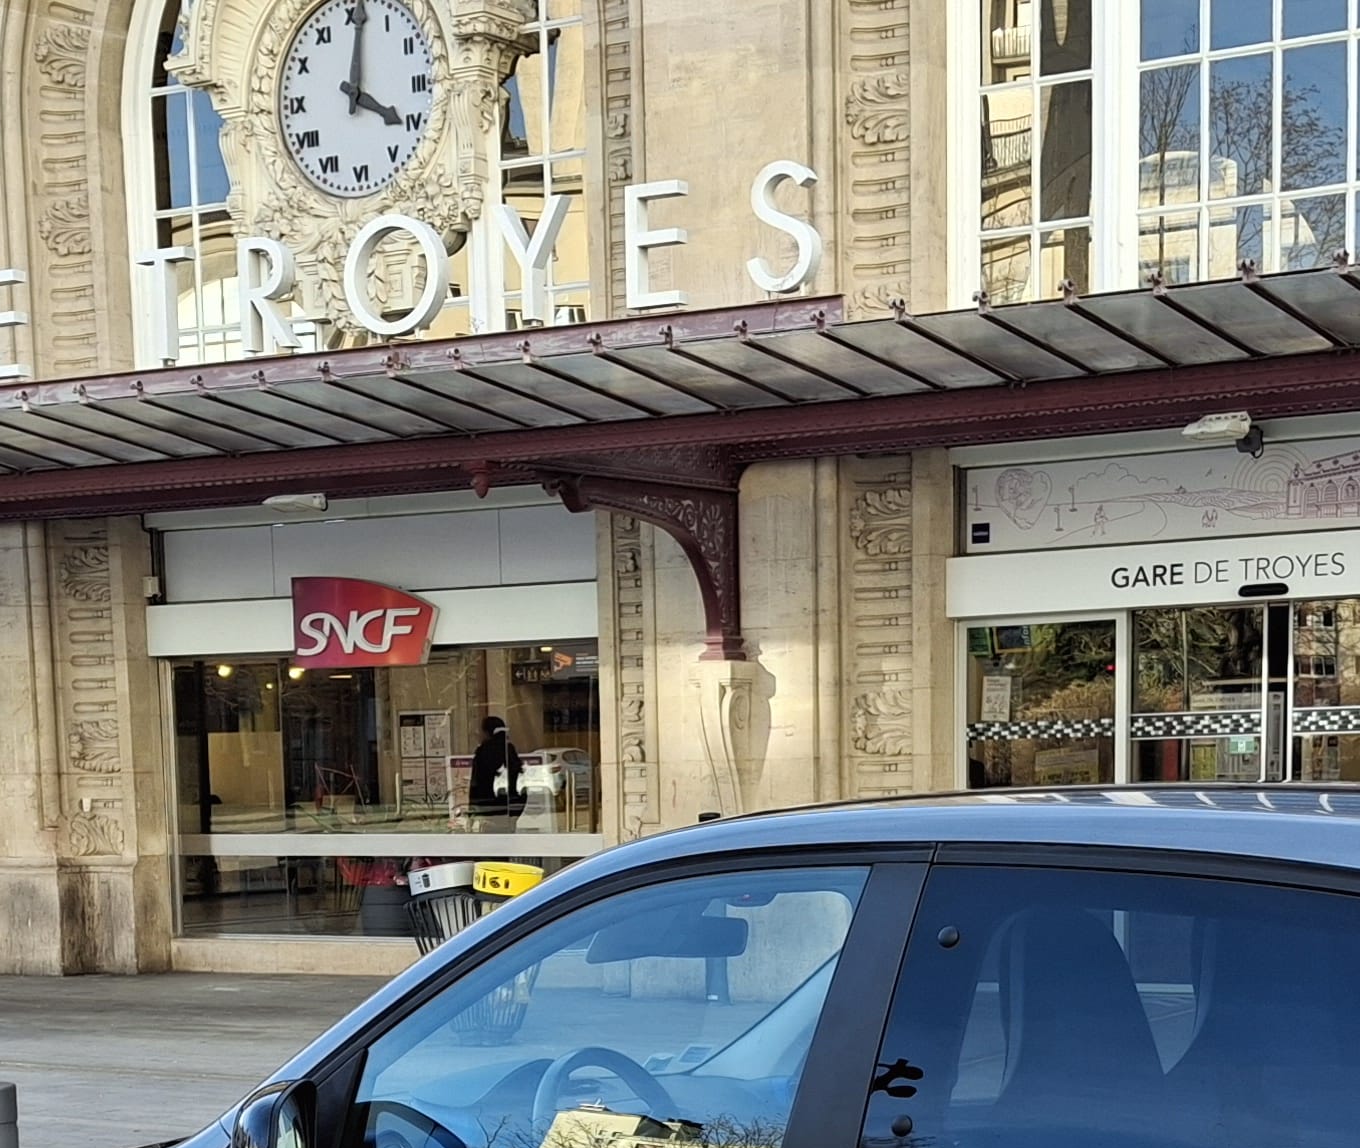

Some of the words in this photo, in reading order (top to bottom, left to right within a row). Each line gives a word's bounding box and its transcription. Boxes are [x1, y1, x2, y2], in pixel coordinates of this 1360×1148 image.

[315, 26, 332, 45] XI
[403, 36, 414, 55] II
[297, 56, 310, 75] X
[411, 73, 427, 93] III
[290, 96, 307, 115] IX
[405, 112, 422, 132] IV
[295, 130, 320, 149] VIII
[387, 144, 399, 163] V
[318, 155, 339, 175] VII
[352, 164, 369, 183] VI
[137, 160, 824, 362] TROYES
[1111, 563, 1184, 588] GARE
[1194, 560, 1229, 584] DE
[1238, 552, 1346, 581] TROYES
[296, 606, 421, 656] SNCF
